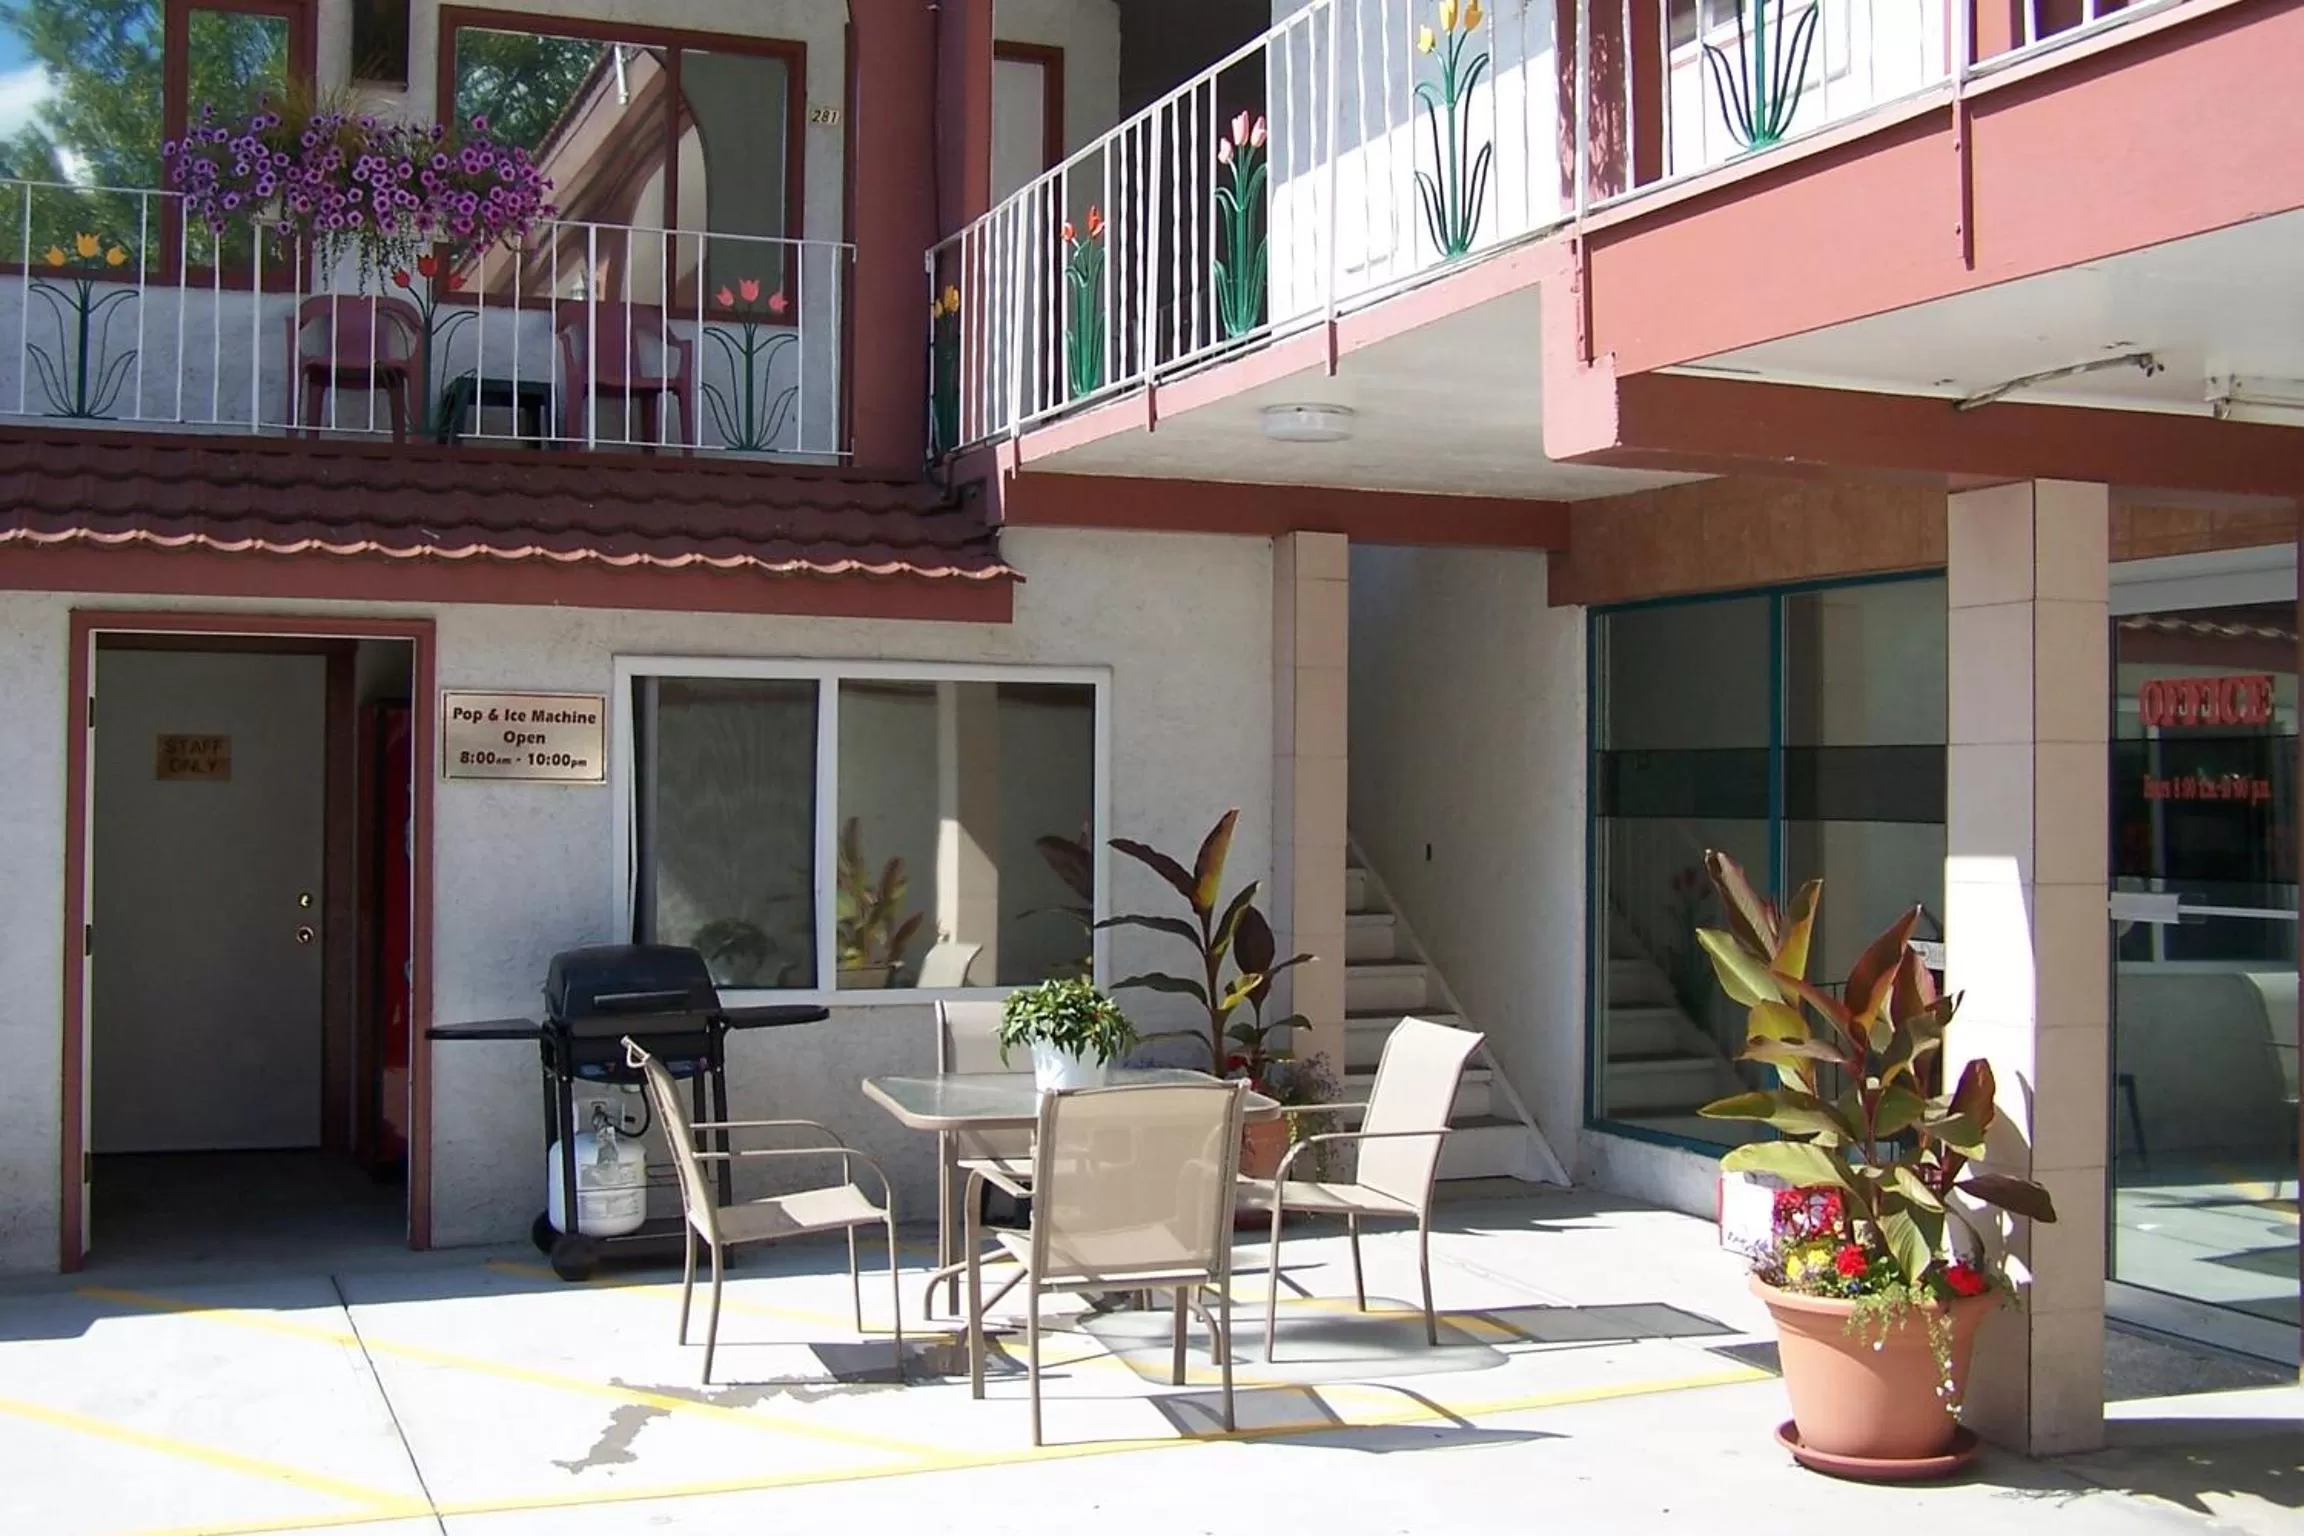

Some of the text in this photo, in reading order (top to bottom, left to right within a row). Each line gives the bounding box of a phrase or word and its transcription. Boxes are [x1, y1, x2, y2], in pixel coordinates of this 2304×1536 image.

[811, 109, 837, 124] 281
[2139, 673, 2275, 727] OFFICE
[452, 707, 597, 725] Pop & Ice Machine
[163, 738, 224, 755] STAFF
[503, 730, 546, 747] Open
[169, 757, 218, 773] ONLY
[528, 752, 588, 769] 10:00pm
